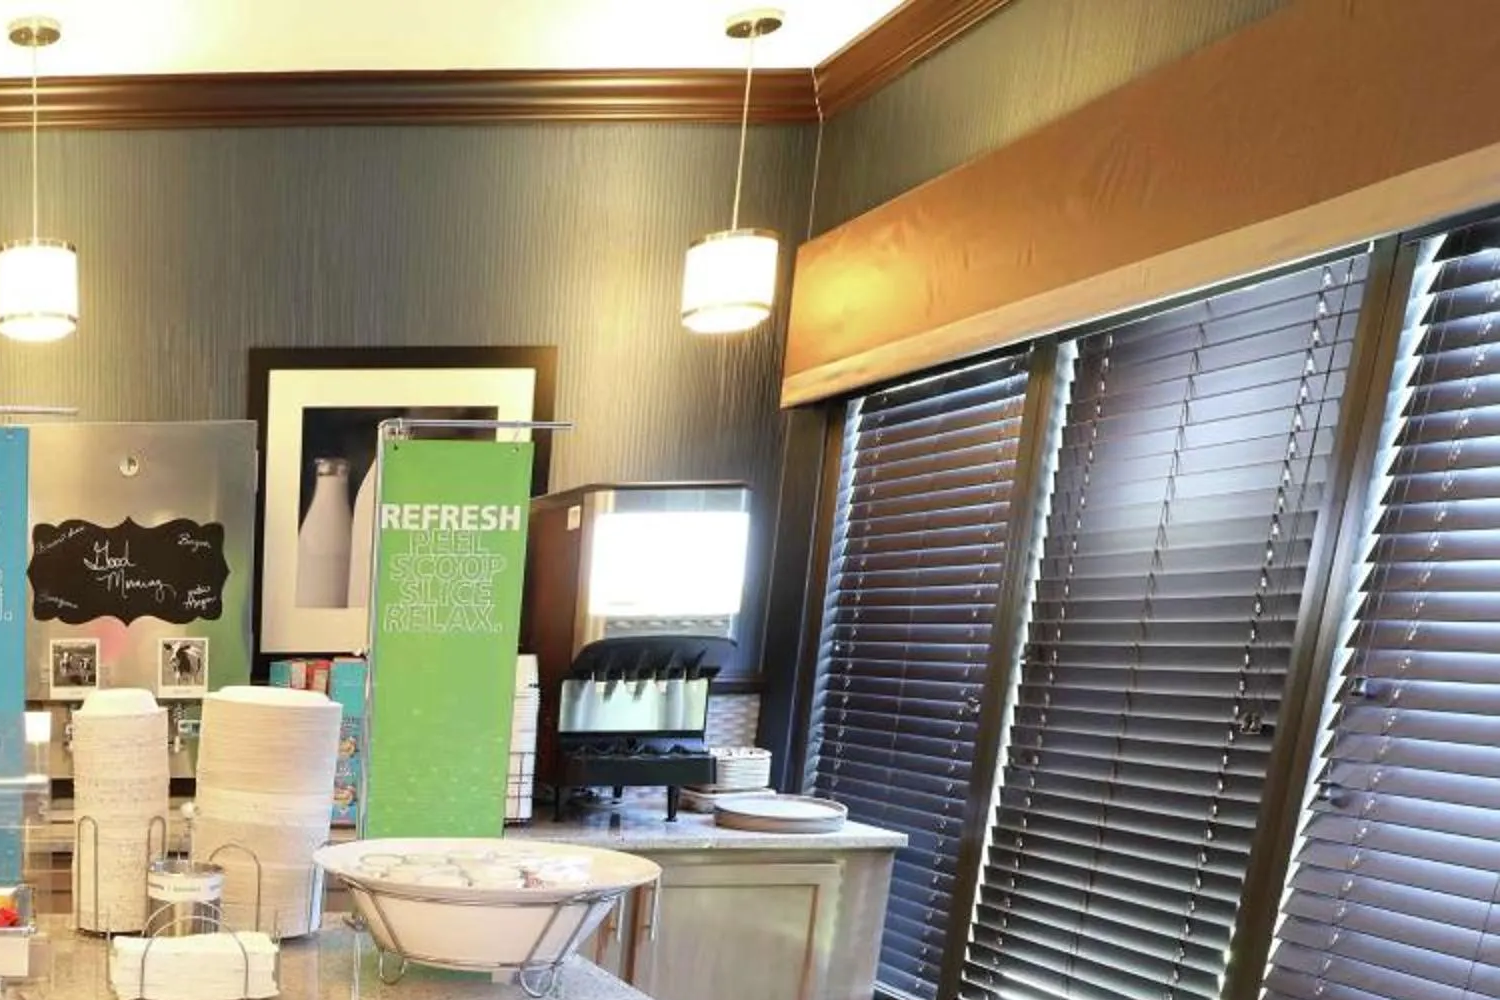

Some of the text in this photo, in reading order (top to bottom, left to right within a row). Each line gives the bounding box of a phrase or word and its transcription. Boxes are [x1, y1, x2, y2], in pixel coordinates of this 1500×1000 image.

[381, 503, 520, 531] REFRESH
[83, 540, 136, 571] Good
[410, 528, 488, 556] PEEL
[390, 553, 506, 583] SCOOP
[97, 568, 177, 603] Morning
[400, 578, 495, 607] SLICE
[384, 602, 503, 633] RELAX.
